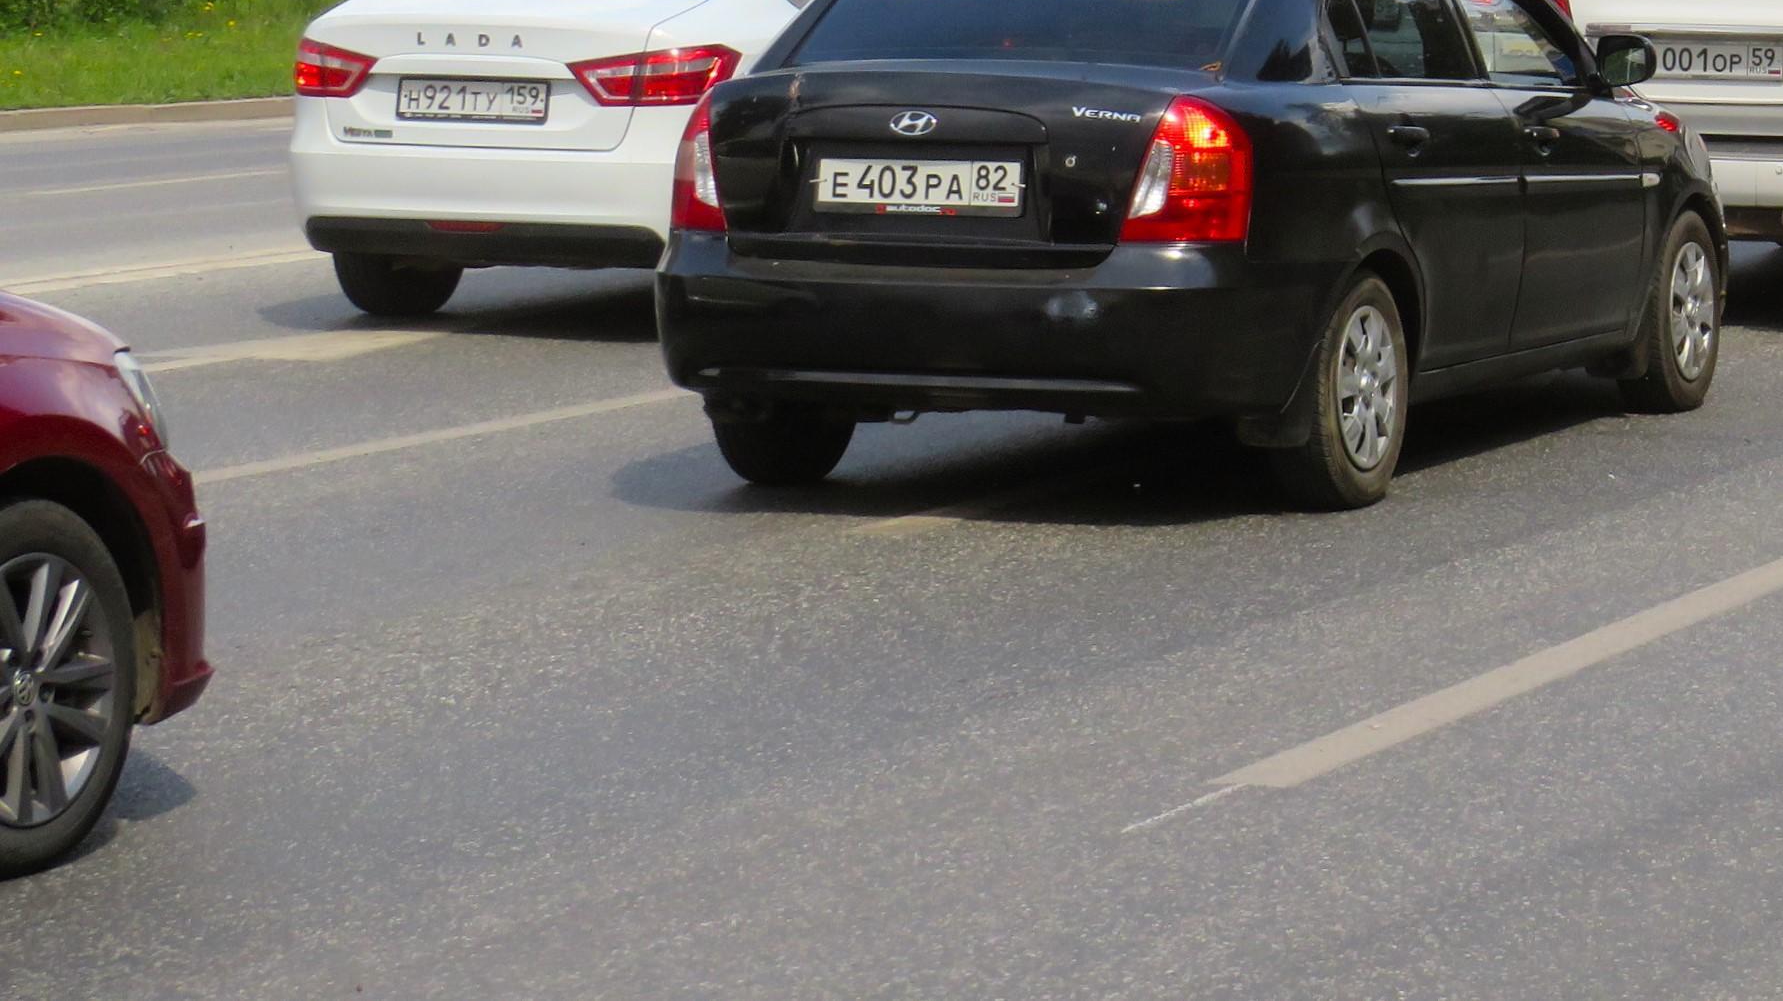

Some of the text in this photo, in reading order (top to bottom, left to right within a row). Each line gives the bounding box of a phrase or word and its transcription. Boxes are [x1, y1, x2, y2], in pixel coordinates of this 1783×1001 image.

[416, 32, 523, 48] LADA
[1751, 47, 1776, 67] 59
[505, 85, 541, 106] 159
[974, 165, 1008, 192] 82
[973, 191, 997, 203] RUS
